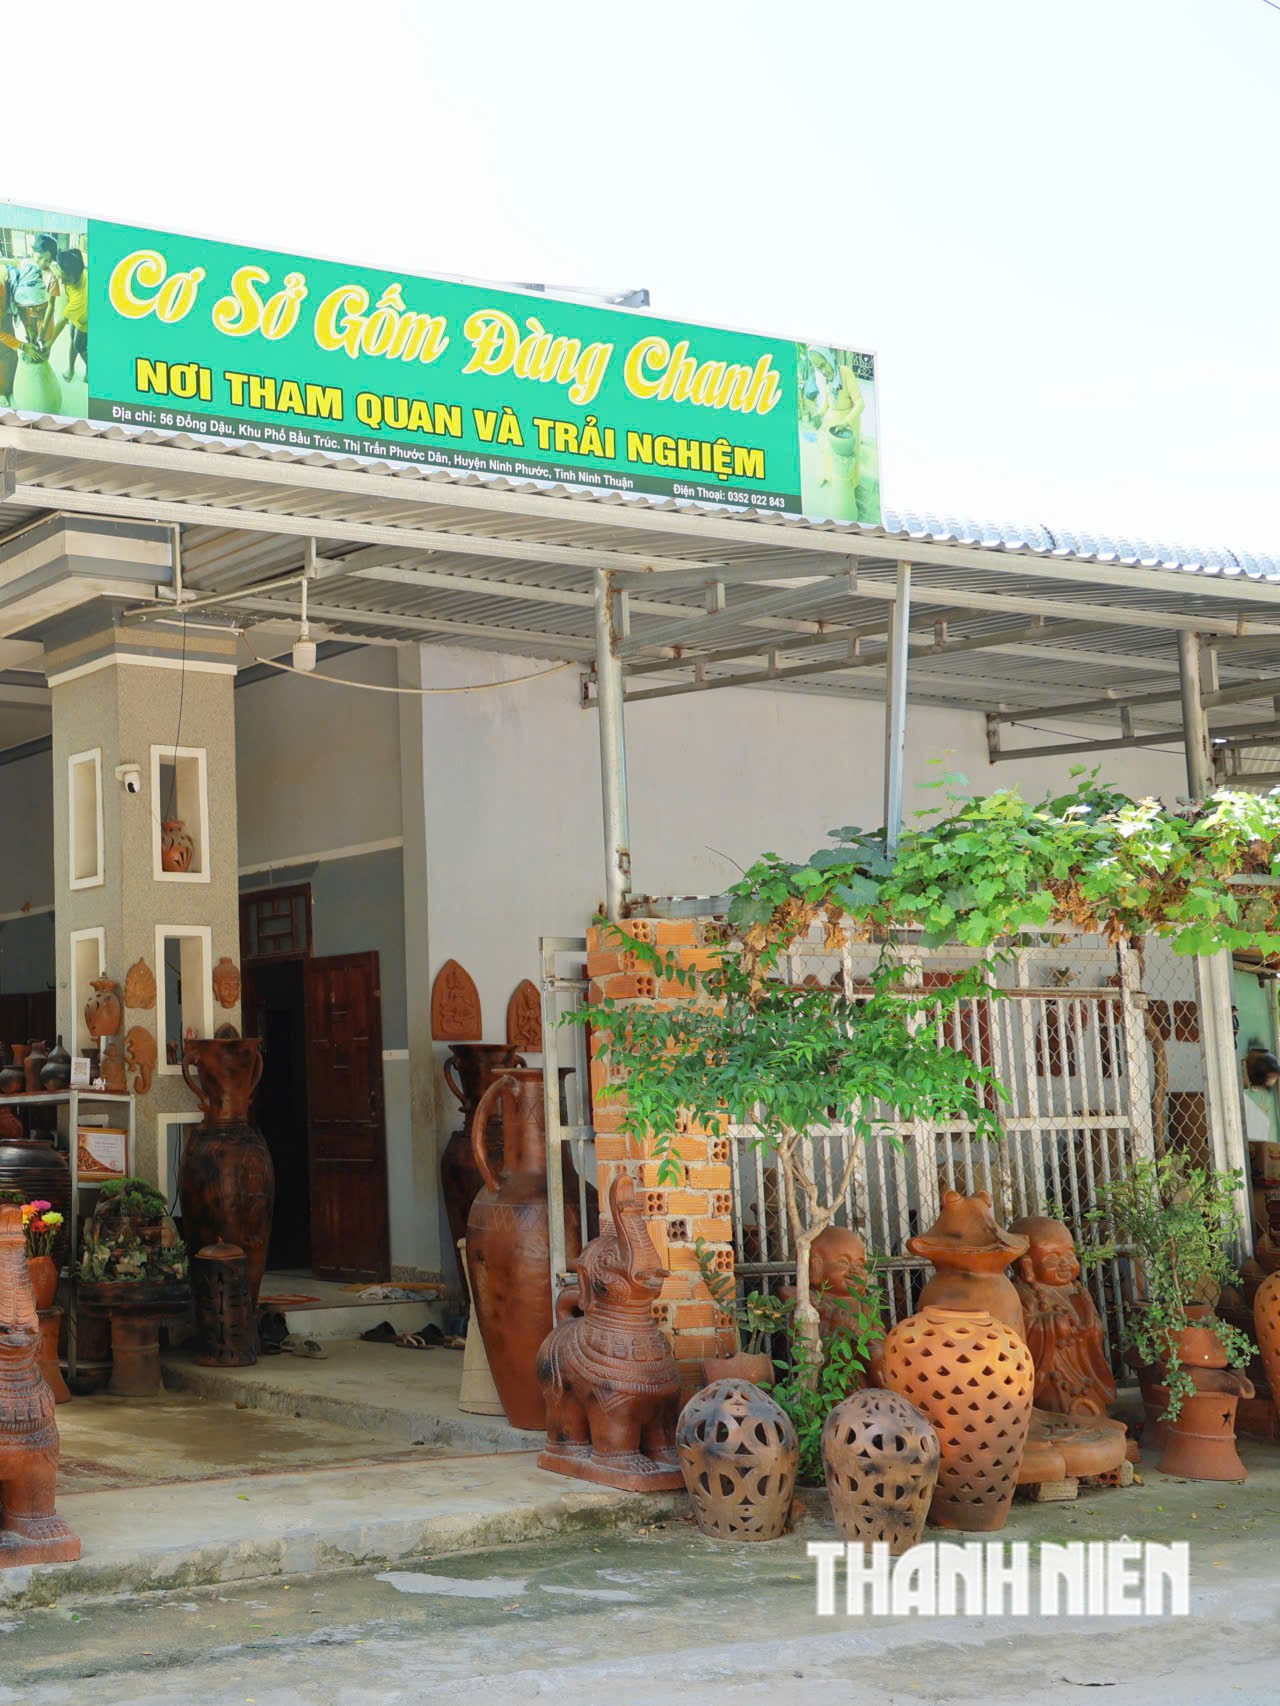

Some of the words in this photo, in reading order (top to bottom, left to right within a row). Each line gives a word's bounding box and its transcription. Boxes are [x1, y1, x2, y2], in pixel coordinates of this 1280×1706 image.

[109, 249, 206, 323] Cơ
[212, 265, 308, 340] Sở
[314, 282, 450, 364] Gốm
[462, 309, 614, 406] Đàng
[624, 336, 782, 415] Chanh
[112, 406, 132, 421] Địa
[160, 413, 174, 426] 56
[210, 420, 236, 436] Dậu,
[239, 424, 261, 438] Khu
[264, 427, 286, 441] Phố
[289, 429, 311, 445] Bầu
[343, 439, 361, 454] Thị
[363, 442, 387, 456] Trấn
[389, 446, 425, 460] Phước
[428, 451, 451, 465] Dân,
[454, 456, 487, 471] Huyện
[489, 460, 513, 473] Ninh
[515, 463, 552, 479] Phước,
[578, 471, 601, 484] Ninh
[603, 474, 634, 490] Thuận
[135, 357, 212, 401] NƠI
[224, 371, 343, 420] THAM
[356, 391, 462, 438] QUAN
[472, 406, 524, 447] VÀ
[533, 414, 616, 459] TRẢI
[626, 430, 766, 481] NGHIỆM
[673, 484, 695, 498] Điện
[697, 487, 726, 502] Thoại:
[727, 491, 749, 504] 0352
[751, 494, 768, 506] 022
[769, 496, 786, 508] 843
